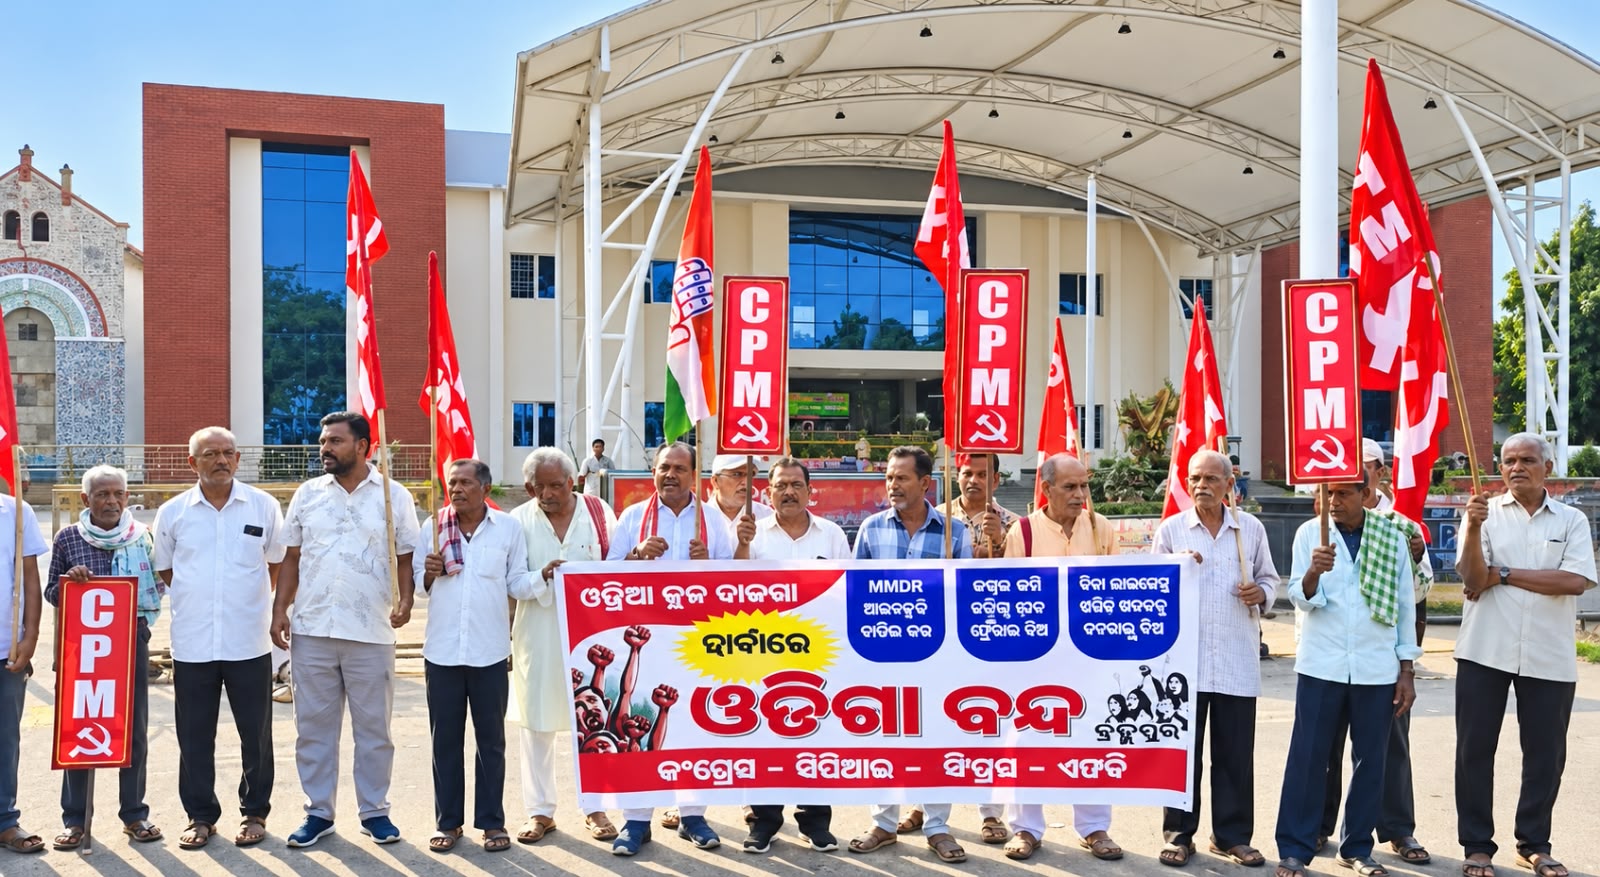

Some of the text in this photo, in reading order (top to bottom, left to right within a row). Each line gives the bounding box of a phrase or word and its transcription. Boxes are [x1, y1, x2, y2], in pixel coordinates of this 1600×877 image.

[733, 287, 771, 407] CPM
[971, 281, 1009, 405] CPM
[1304, 292, 1346, 429] CPM
[869, 580, 923, 592] MMDR
[74, 589, 115, 718] CPM
